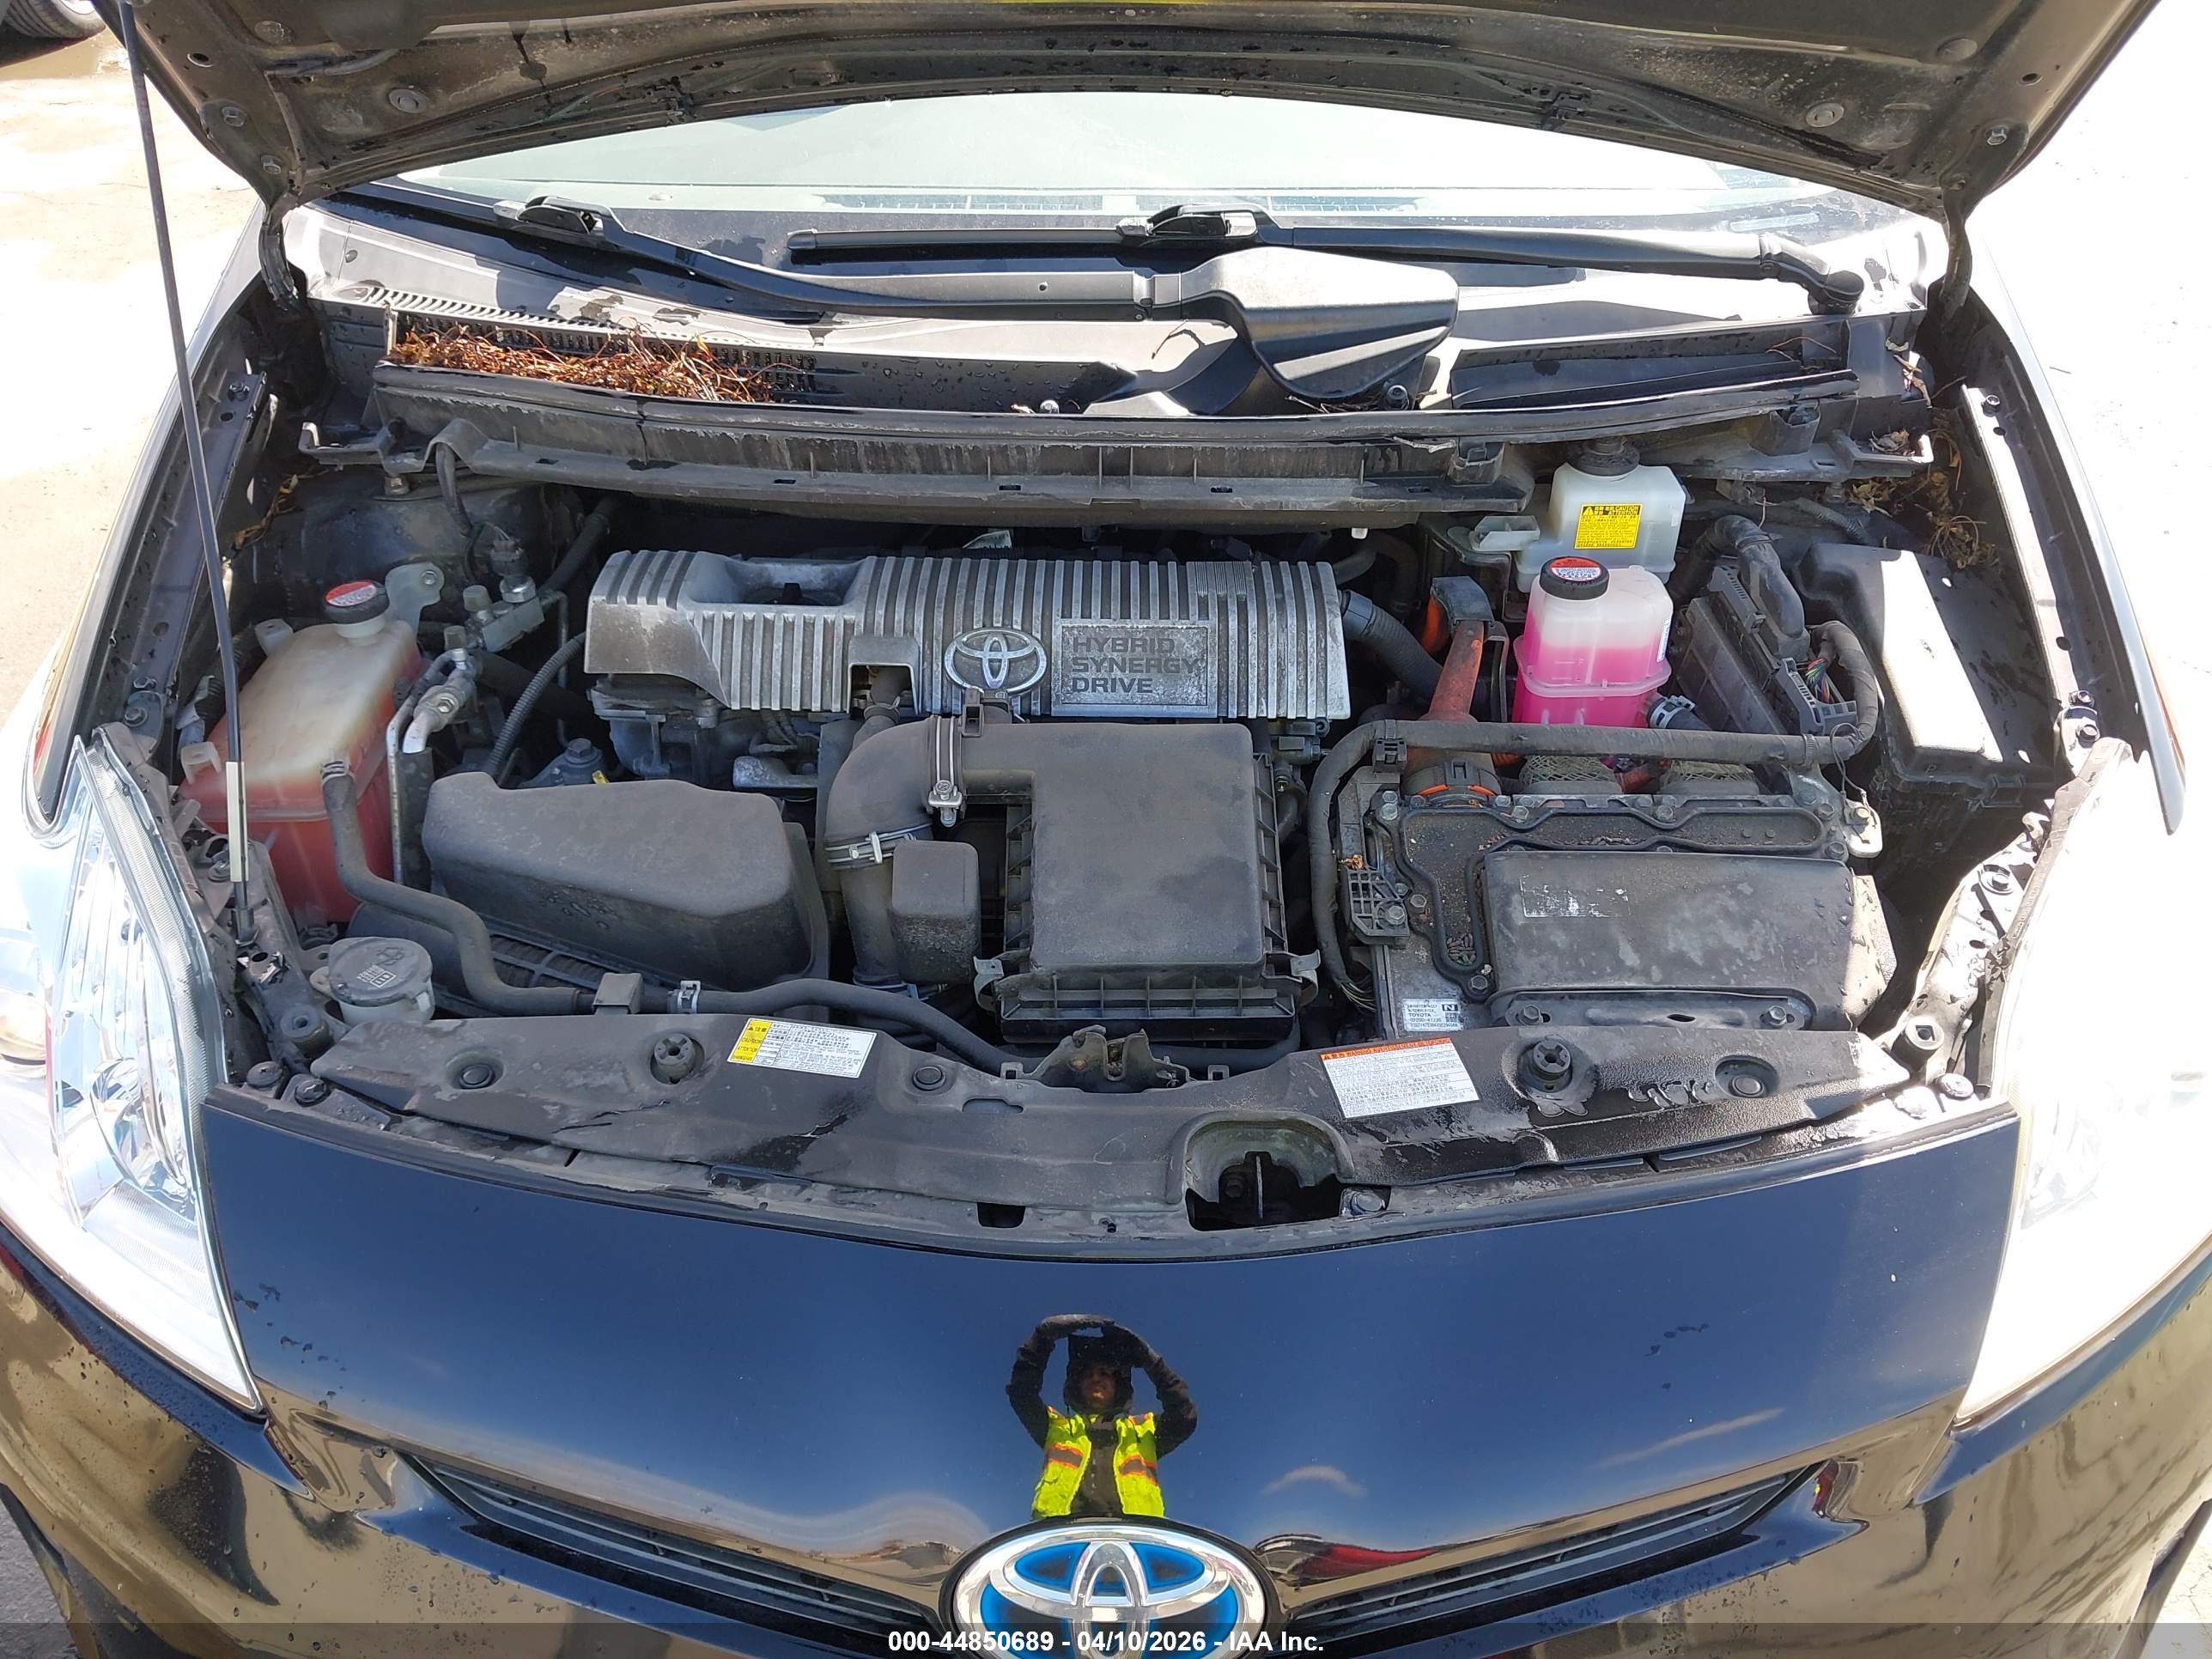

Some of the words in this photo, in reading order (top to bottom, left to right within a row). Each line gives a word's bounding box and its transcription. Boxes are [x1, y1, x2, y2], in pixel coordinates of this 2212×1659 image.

[1073, 637, 1176, 653] HYBRID
[1072, 657, 1200, 673] SYNERGY
[1073, 677, 1154, 693] DRIVE
